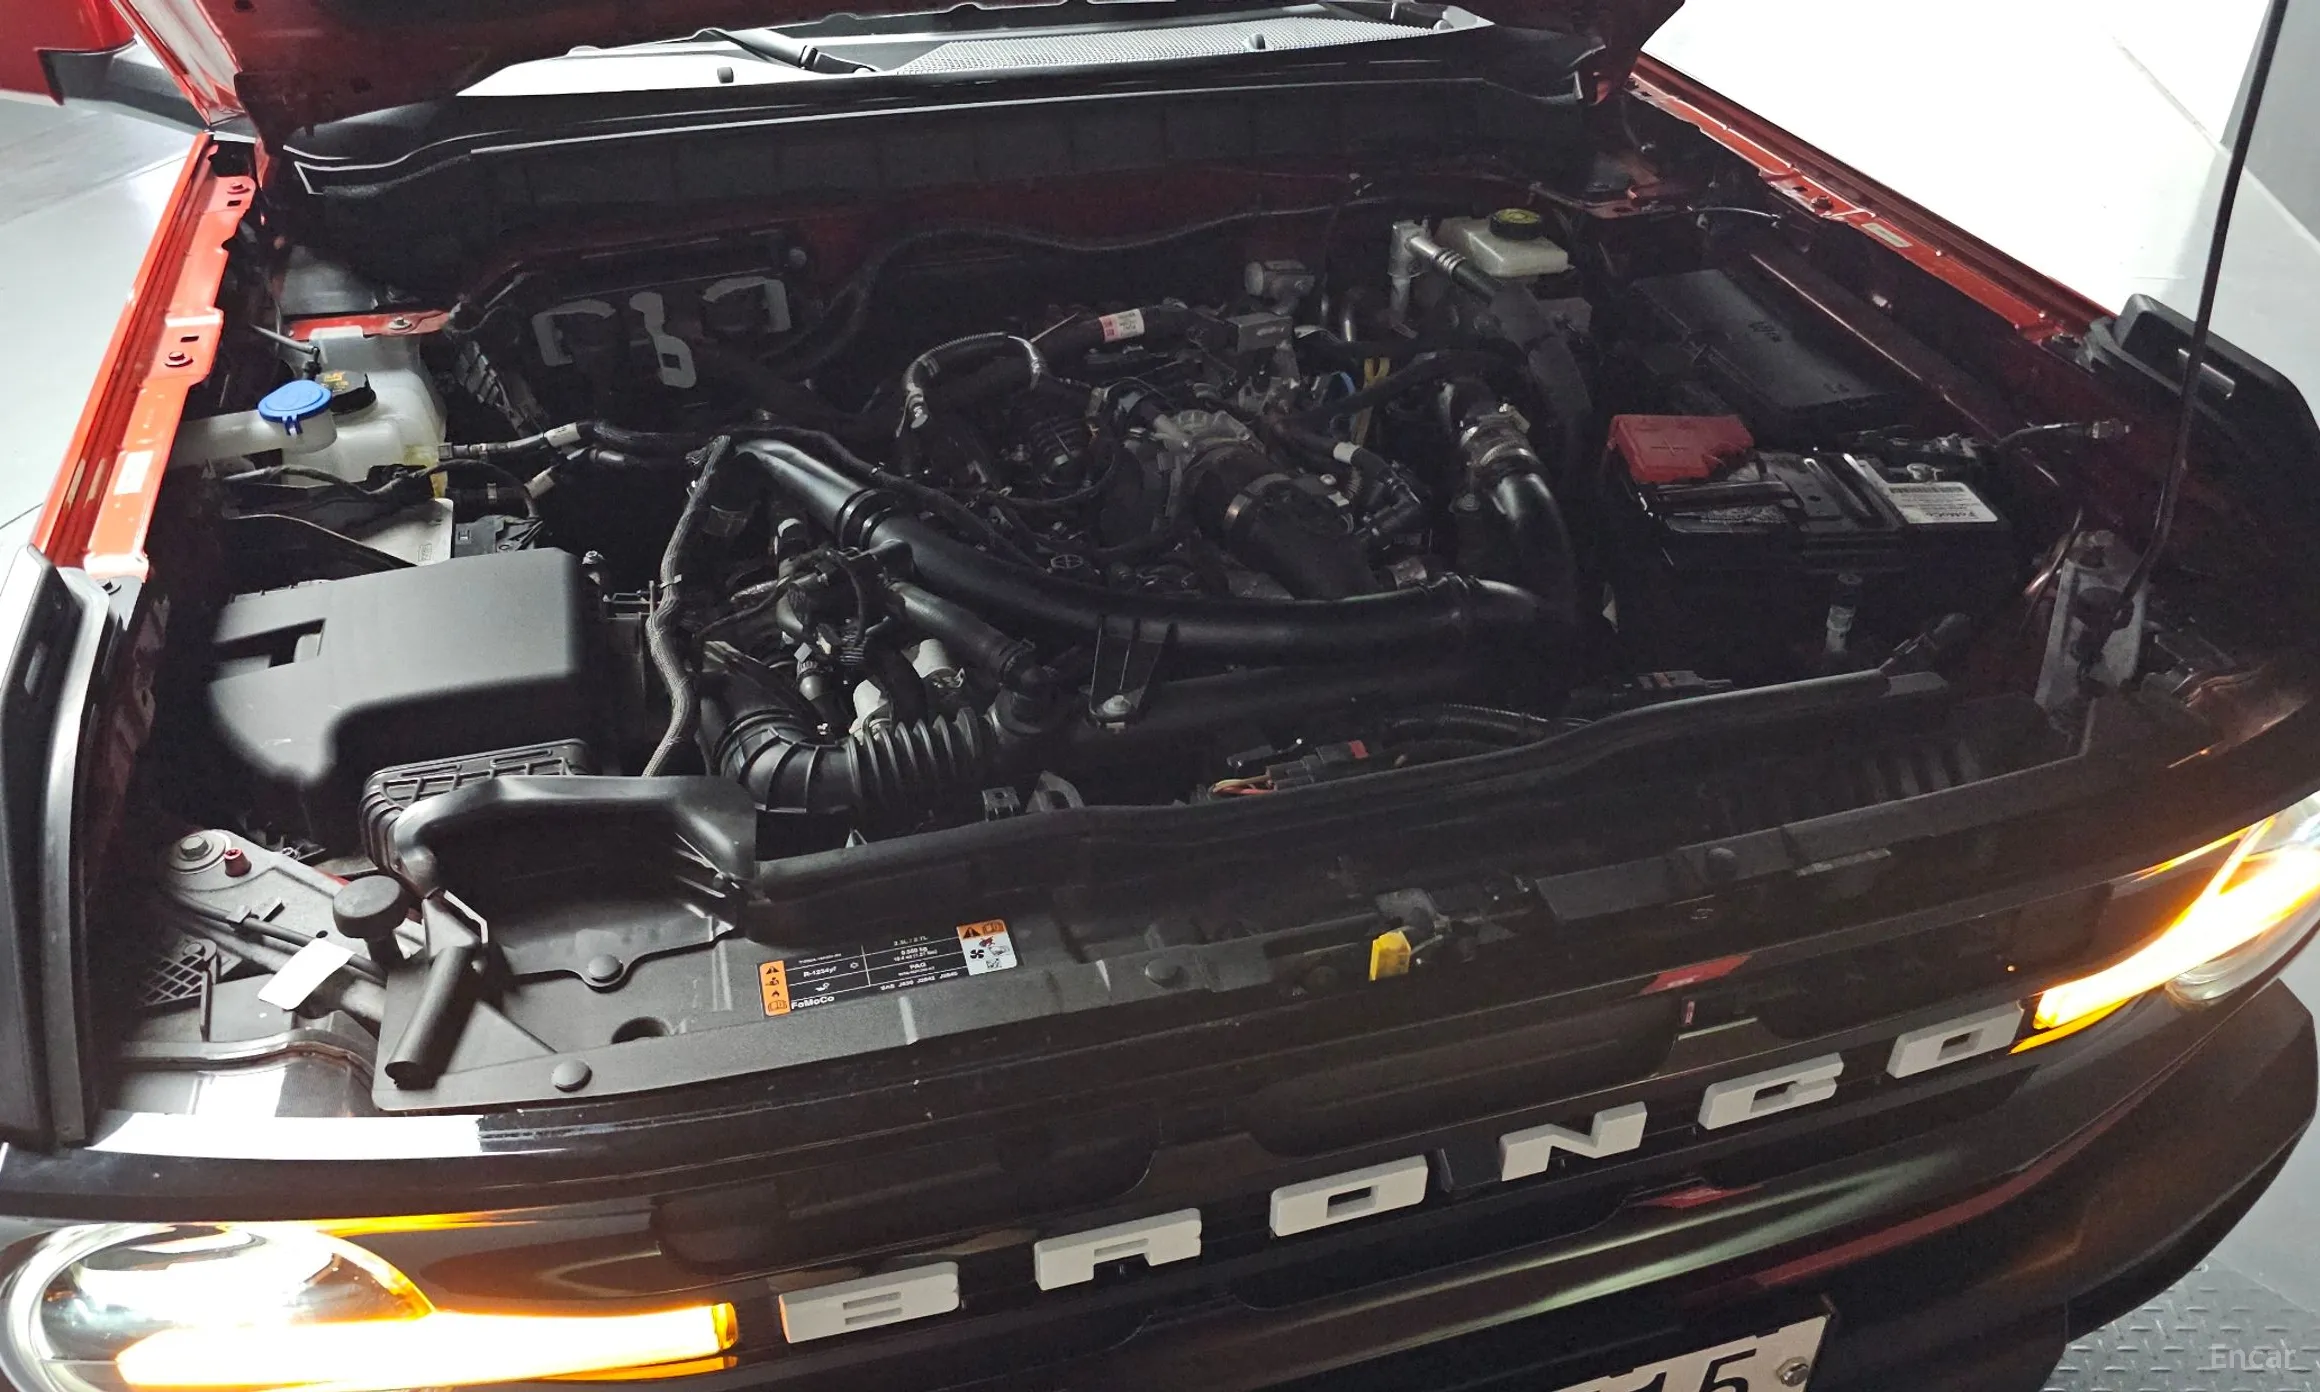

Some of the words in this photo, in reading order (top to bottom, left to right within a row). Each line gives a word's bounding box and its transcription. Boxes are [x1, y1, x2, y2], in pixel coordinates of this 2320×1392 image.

[803, 965, 837, 978] R-1234yf
[909, 962, 927, 970] PAG
[791, 996, 835, 1010] FoMoCo
